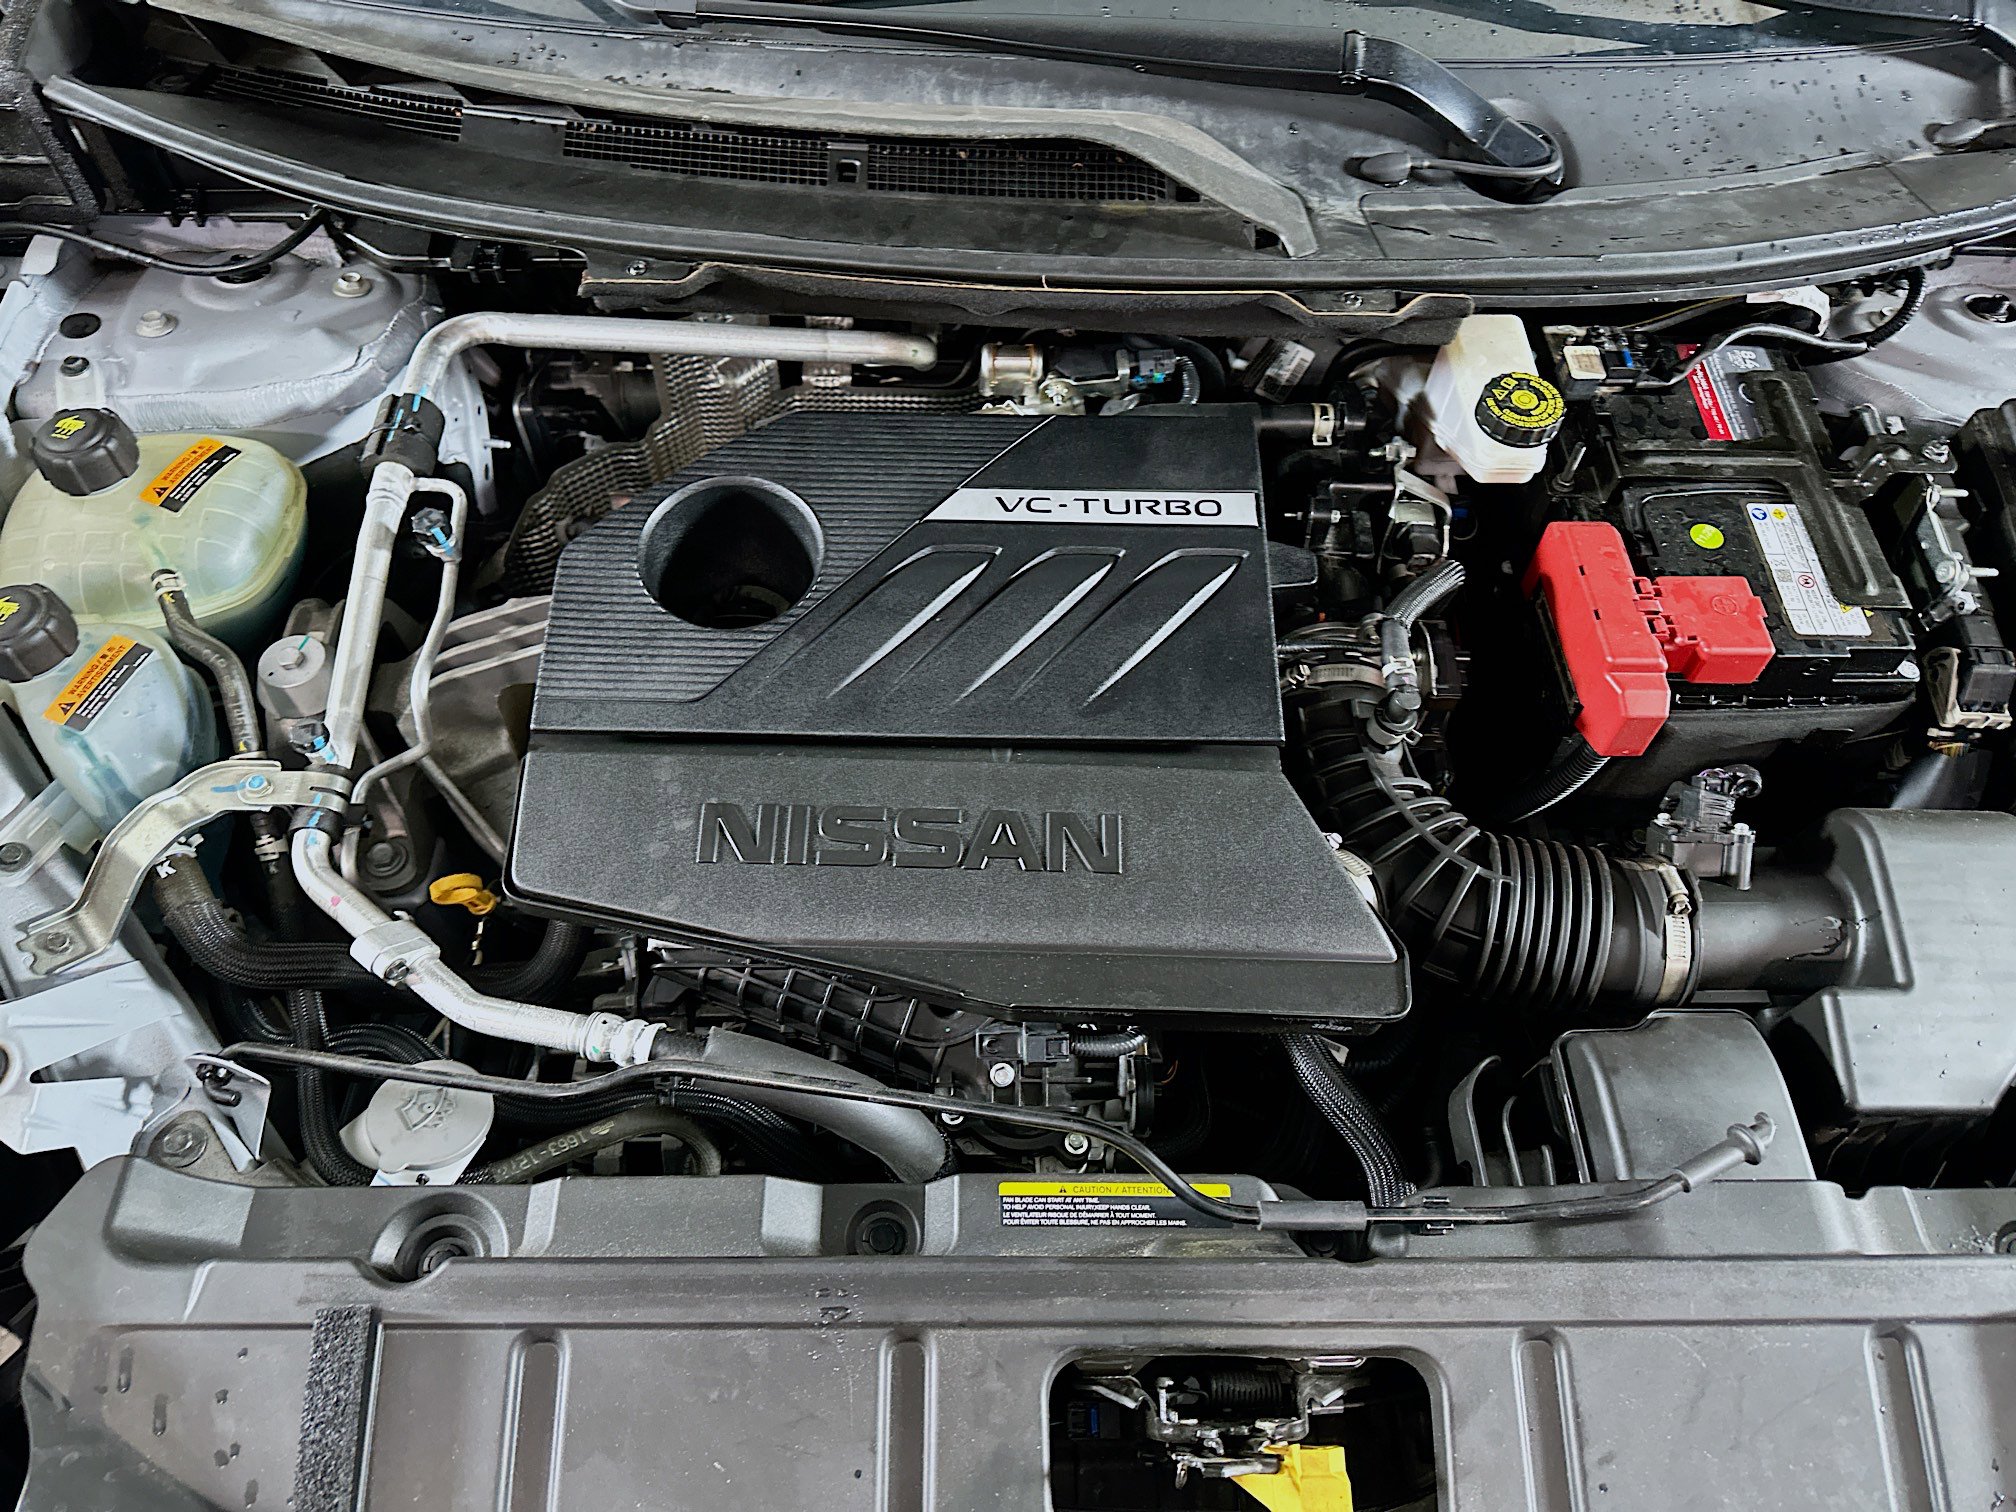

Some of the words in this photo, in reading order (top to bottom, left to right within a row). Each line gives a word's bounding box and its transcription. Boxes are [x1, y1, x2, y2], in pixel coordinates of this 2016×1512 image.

[995, 496, 1223, 517] VC-TURBO
[67, 663, 99, 695] WARNING
[76, 645, 126, 699] AVERTISSEMENT
[696, 803, 1122, 873] NISSAN
[156, 860, 177, 879] K
[1073, 1186, 1112, 1194] CAUTION
[1122, 1186, 1169, 1194] ATTENTION
